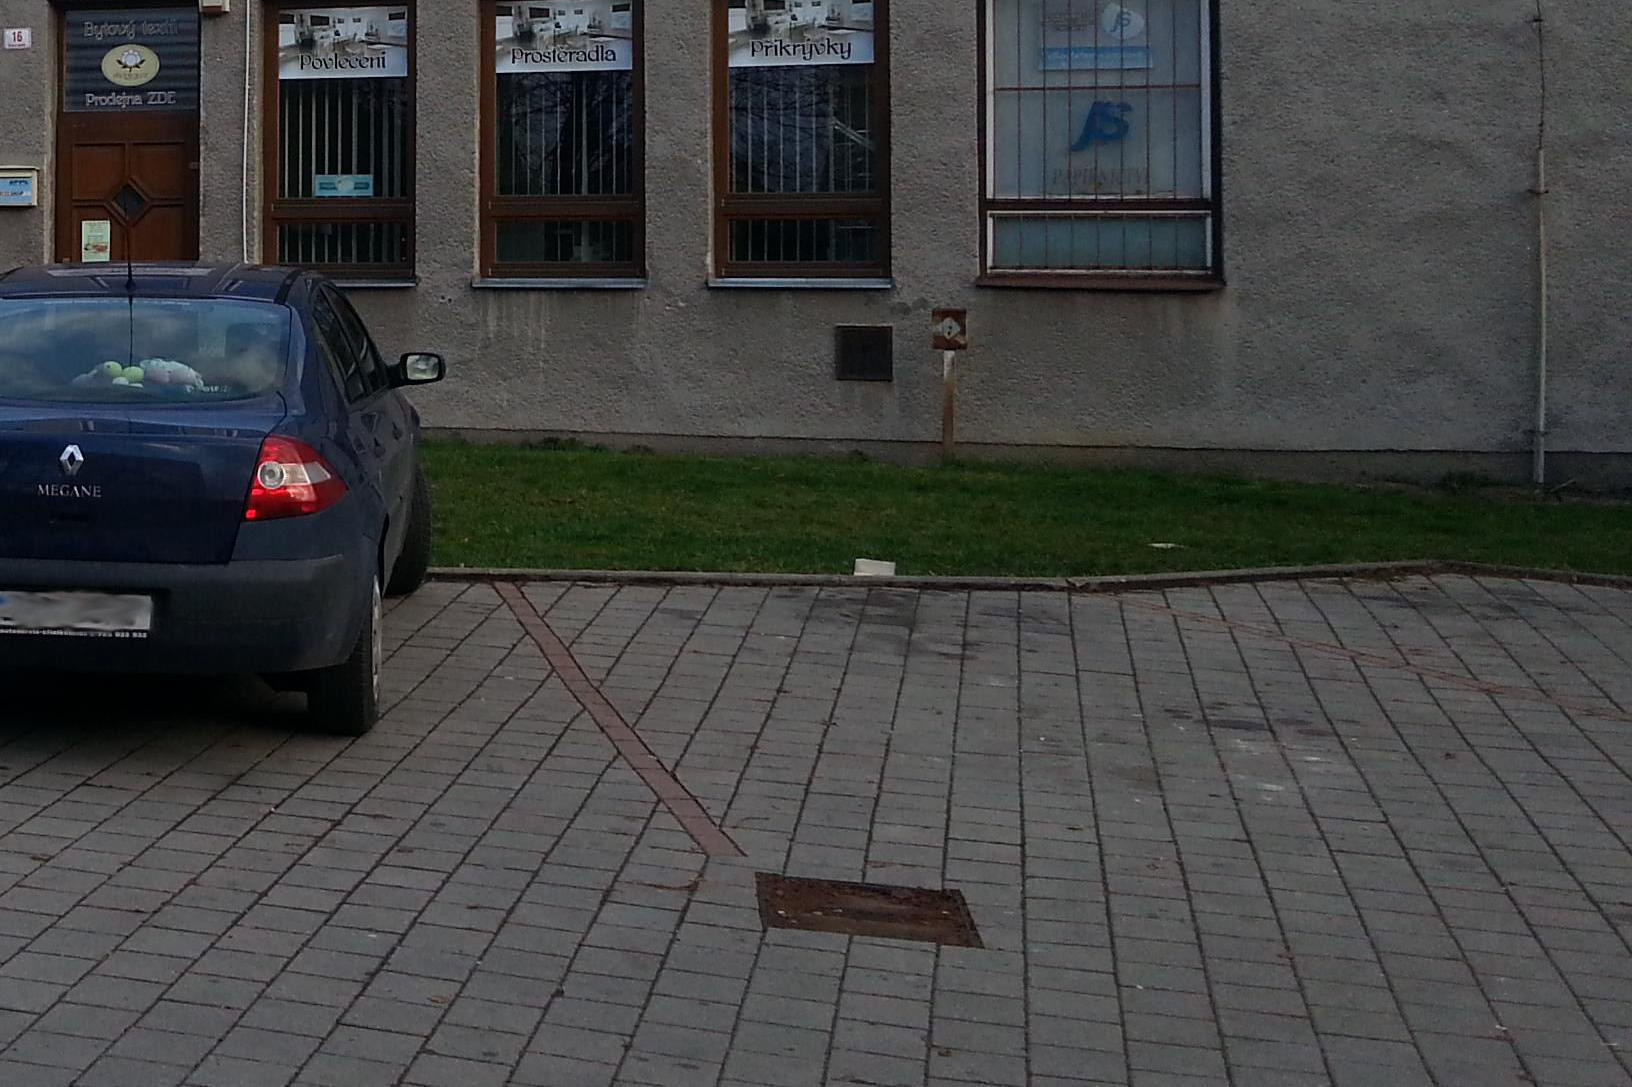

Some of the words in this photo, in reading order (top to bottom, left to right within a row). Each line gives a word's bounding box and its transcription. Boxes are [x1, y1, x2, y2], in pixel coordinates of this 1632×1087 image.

[12, 31, 23, 42] 16
[84, 19, 137, 41] Bytový
[85, 92, 143, 109] Prodejna
[147, 91, 177, 105] ZDE
[37, 484, 102, 498] MEGANE
